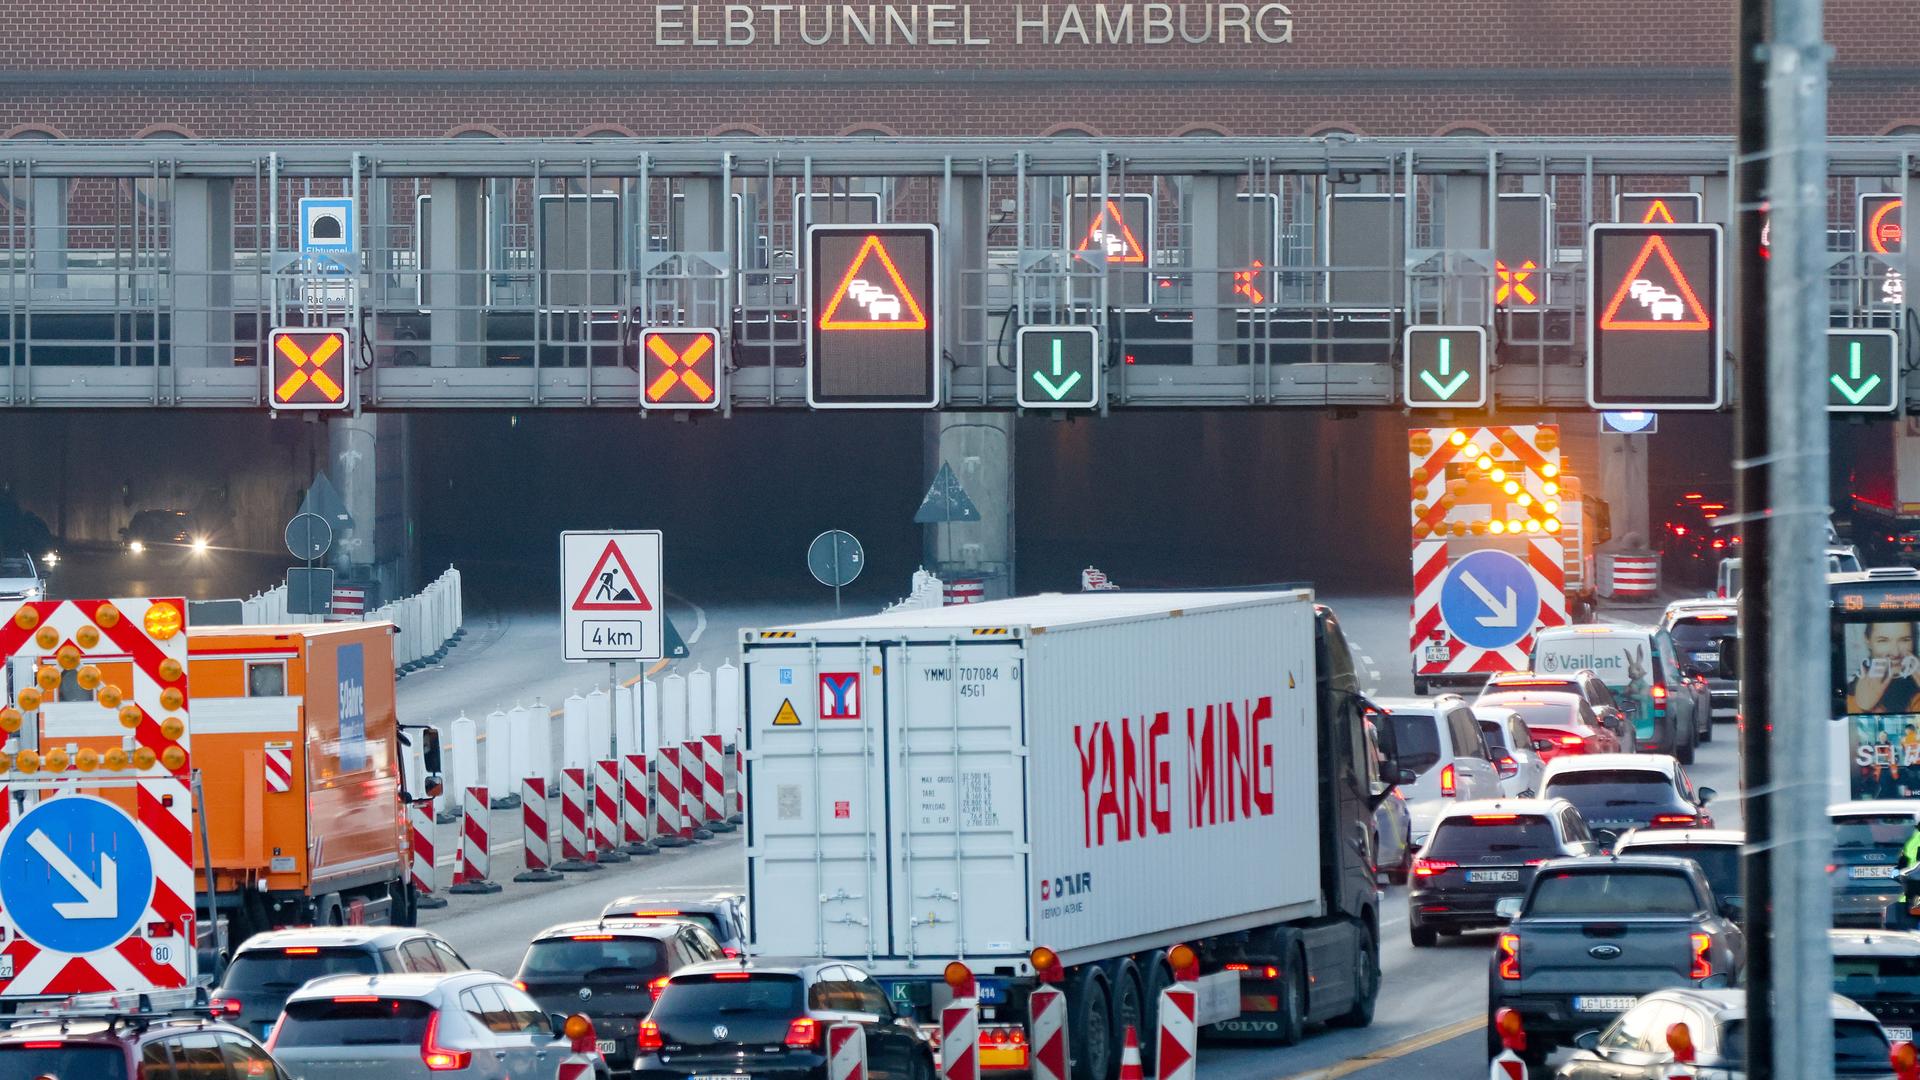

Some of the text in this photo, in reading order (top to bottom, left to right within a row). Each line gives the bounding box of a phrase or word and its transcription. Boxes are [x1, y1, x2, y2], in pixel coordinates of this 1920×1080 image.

[655, 3, 1294, 46] ELBTUNNEL HAMBURG
[592, 627, 633, 645] 4 km
[1559, 654, 1621, 669] Vaillant
[923, 668, 952, 682] YMMU
[959, 667, 999, 681] 707084
[960, 684, 986, 698] 45G1
[1074, 696, 1274, 849] YANG MING
[155, 947, 169, 961] 80
[896, 985, 907, 999] K
[1215, 1021, 1279, 1032] VOLVO
[1887, 1029, 1912, 1040] 3750
